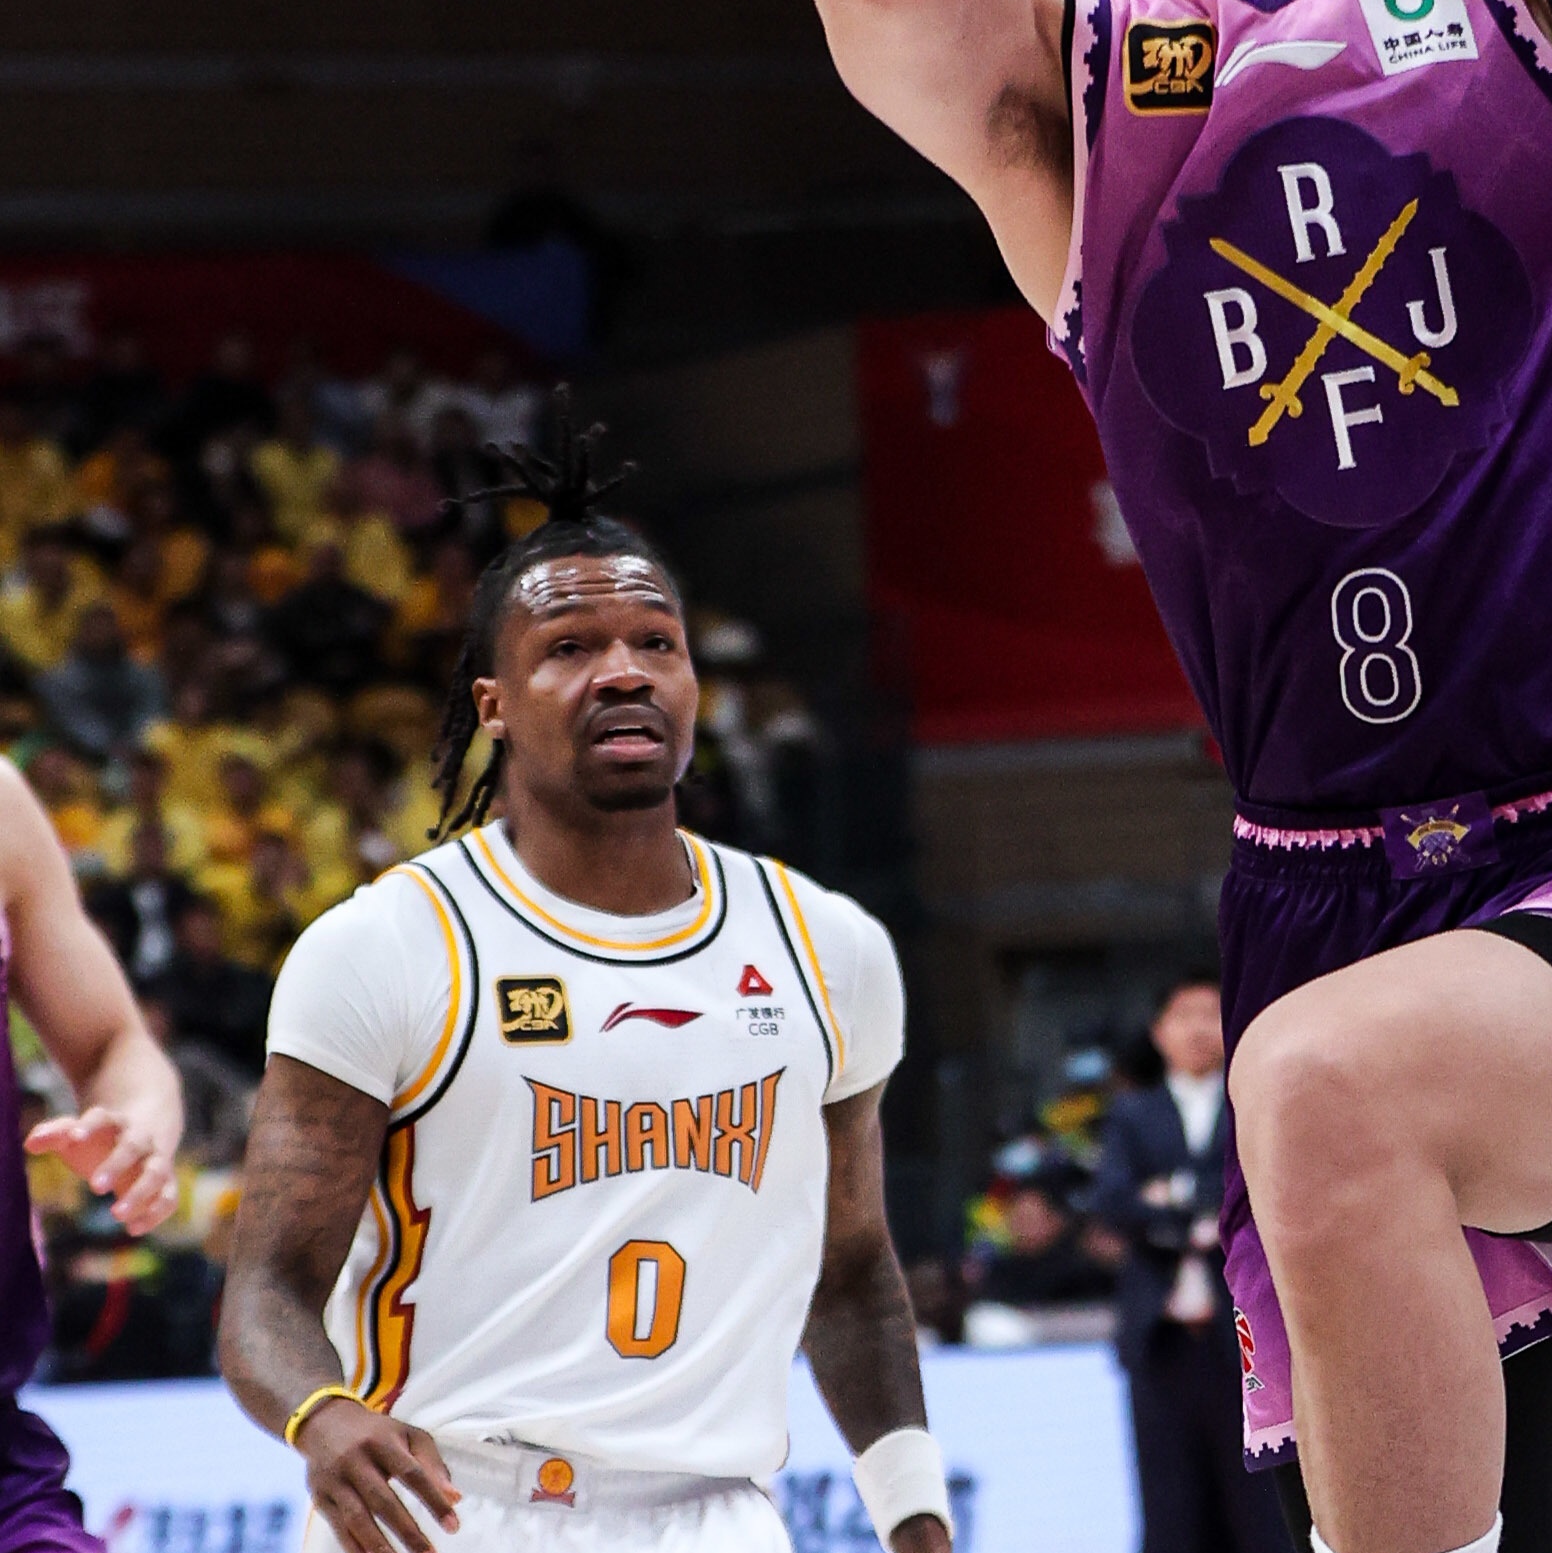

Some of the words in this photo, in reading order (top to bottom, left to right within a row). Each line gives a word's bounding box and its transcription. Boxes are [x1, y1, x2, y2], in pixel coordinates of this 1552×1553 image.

[1438, 39, 1468, 51] LIFE
[1277, 162, 1347, 263] R
[1203, 287, 1268, 391] B
[1406, 247, 1458, 349] J
[1321, 365, 1384, 471] F
[1331, 567, 1422, 724] 8
[748, 1022, 780, 1037] CGB
[520, 1065, 788, 1204] SHANXI
[606, 1238, 687, 1360] 0
